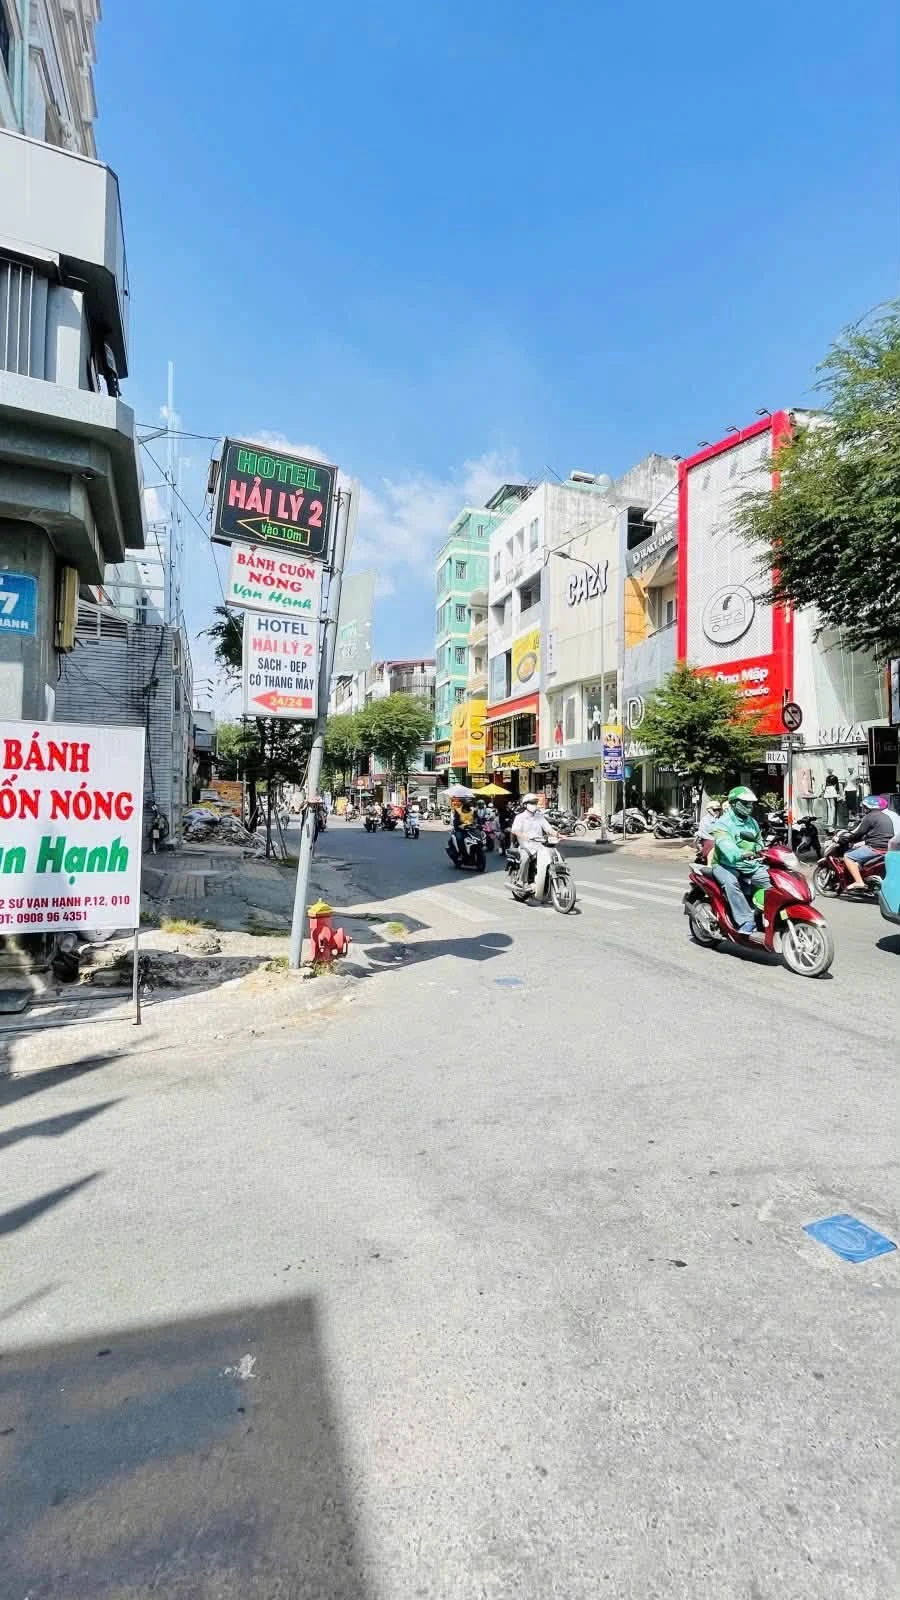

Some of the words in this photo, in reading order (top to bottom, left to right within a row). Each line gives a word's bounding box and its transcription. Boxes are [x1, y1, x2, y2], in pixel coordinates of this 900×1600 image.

[237, 449, 321, 492] HOTEL
[228, 476, 272, 514] HẢI
[277, 488, 304, 521] LÝ
[308, 500, 323, 528] 2
[282, 526, 302, 541] 10m
[237, 553, 276, 572] BÁNH
[278, 563, 316, 580] CUỐN
[248, 572, 302, 592] NÓNG
[233, 583, 262, 599] Vạn
[268, 592, 312, 609] Hạnh
[257, 618, 309, 636] HOTEL
[252, 634, 278, 653] HẢI
[283, 639, 300, 655] LÝ
[303, 644, 313, 657] 2
[257, 657, 282, 673] SẠCH
[741, 667, 769, 682] Mập
[249, 671, 261, 686] CÓ
[264, 675, 293, 689] THANG
[295, 676, 314, 691] MÁY
[270, 696, 304, 707] 24/24
[818, 724, 869, 744] RUZA
[3, 731, 91, 773] BÁNH
[767, 752, 787, 762] RUZA
[50, 781, 134, 821] NÓNG
[0, 845, 27, 874] n
[36, 835, 129, 886] Hạnh
[9, 897, 25, 909] SƯ
[27, 897, 49, 911] VẠN
[52, 896, 81, 910] HẠNH
[17, 912, 43, 924] 0908
[47, 911, 60, 922] 96
[63, 911, 88, 921] 4351
